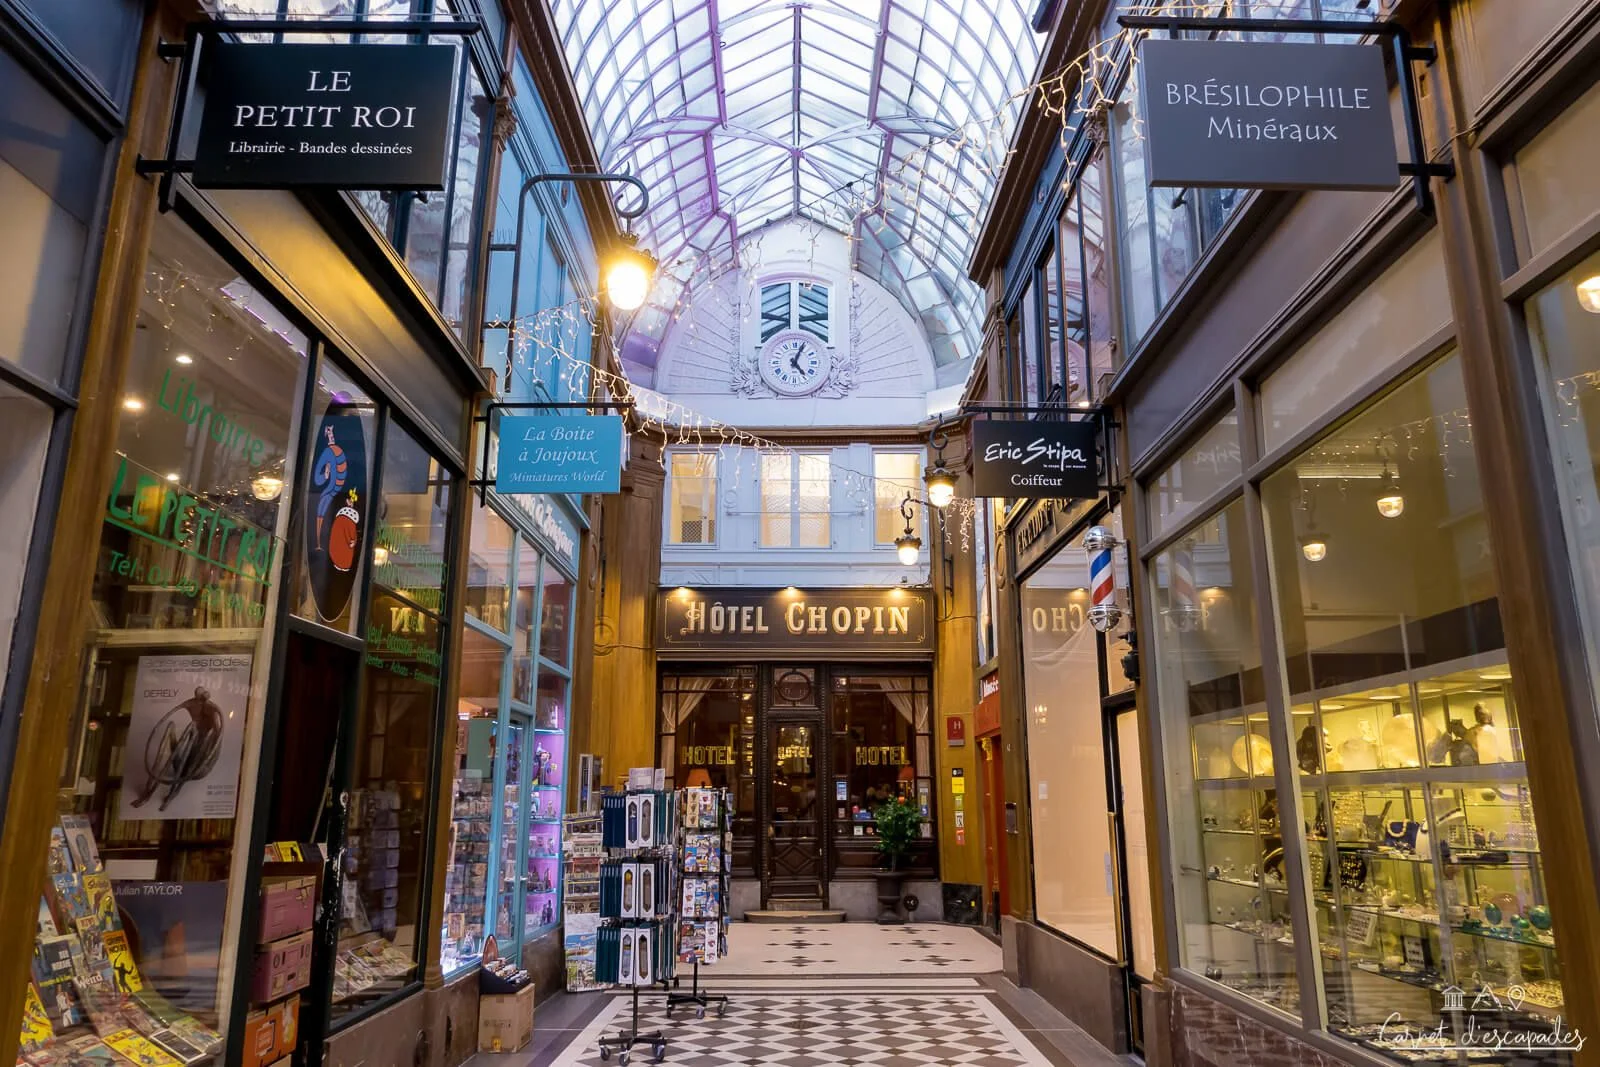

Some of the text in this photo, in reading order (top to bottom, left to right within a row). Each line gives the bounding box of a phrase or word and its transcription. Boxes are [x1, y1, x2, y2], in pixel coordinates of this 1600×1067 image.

[307, 70, 352, 92] LE
[1166, 78, 1371, 110] BRÉSILOPHILE
[233, 105, 416, 129] PETIT ROI
[1207, 117, 1338, 142] Minéraux
[229, 141, 286, 155] Librairie
[300, 142, 347, 155] Bandes
[350, 142, 413, 156] dessinées
[158, 368, 265, 467] Librairie
[523, 426, 595, 442] La Boite
[518, 447, 599, 465] à Joujoux
[984, 438, 1087, 471] Eric Stipa
[509, 470, 607, 483] Miniatures World
[1011, 474, 1063, 487] Coiffeur
[106, 457, 160, 526] LE
[159, 491, 237, 567] PETIT
[682, 601, 910, 635] HÔTEL CHOPIN
[143, 687, 180, 698] DERELY
[681, 745, 737, 765] HOTEL
[855, 745, 911, 765] HOTEL
[113, 884, 184, 897] Julian TAYLOR
